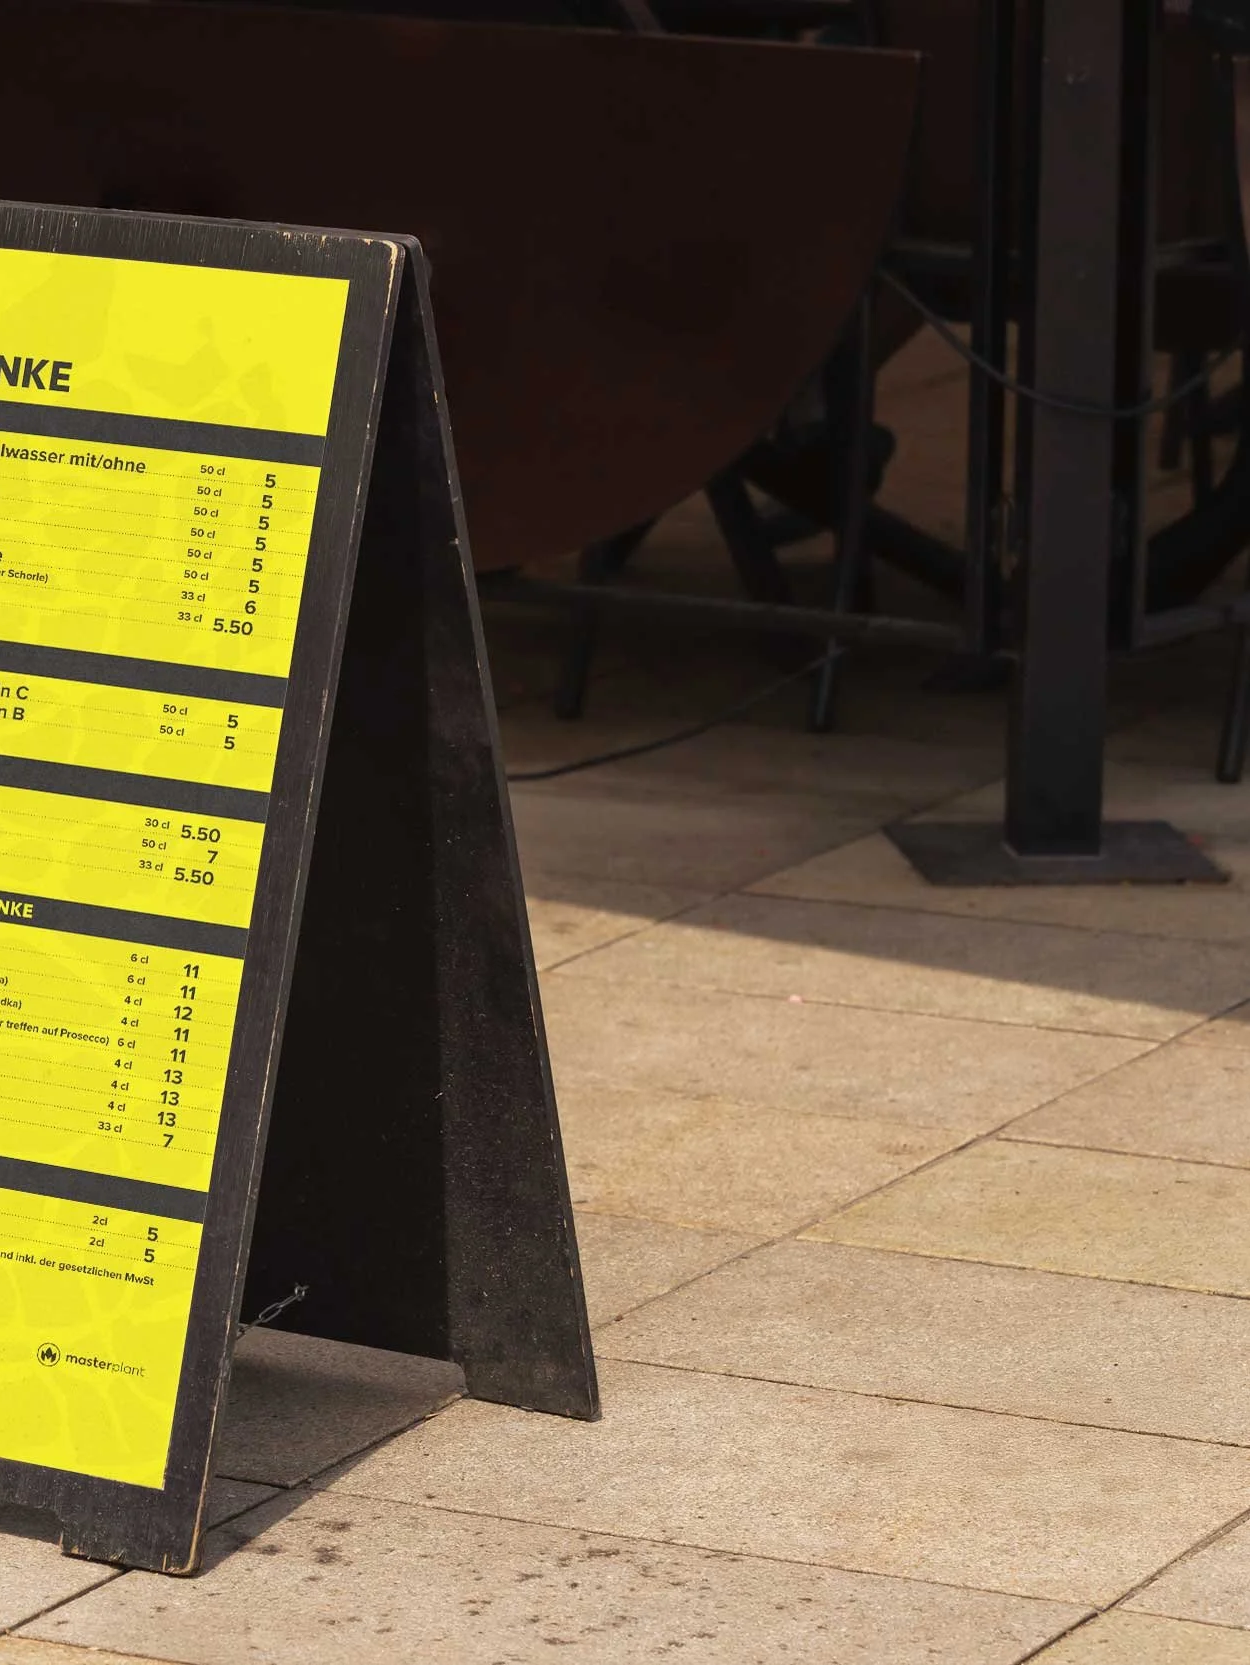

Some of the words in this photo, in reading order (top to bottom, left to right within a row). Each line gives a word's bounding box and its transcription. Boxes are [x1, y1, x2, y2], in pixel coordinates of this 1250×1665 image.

[69, 452, 146, 474] mit/ohne
[200, 464, 215, 475] 50
[216, 467, 226, 476] cl
[265, 473, 277, 489] 5
[197, 485, 211, 496] 50
[261, 494, 273, 510] 5
[193, 506, 208, 516] 50
[258, 515, 270, 531] 5
[190, 527, 205, 538] 50
[255, 536, 267, 552] 5
[187, 548, 202, 559] 50
[203, 551, 213, 560] cl
[251, 557, 263, 573] 5
[7, 568, 49, 584] Schorle)
[181, 590, 195, 601] 33
[244, 600, 257, 615] 6
[183, 569, 198, 579] 50
[248, 579, 260, 594] 5
[177, 611, 191, 622] 33
[212, 618, 254, 636] 5.50
[15, 685, 30, 701] C
[162, 704, 177, 714] 50
[179, 707, 188, 716] cl
[227, 714, 239, 729] 5
[12, 706, 25, 721] B
[159, 724, 174, 735] 50
[223, 735, 235, 750] 5
[144, 817, 159, 828] 30
[180, 824, 221, 843] 5.50
[141, 838, 156, 849] 50
[158, 841, 167, 851] cl
[207, 849, 219, 864] 7
[139, 859, 153, 870] 33
[173, 866, 214, 886] 5.50
[130, 953, 138, 963] 6
[140, 955, 149, 964] cl
[183, 963, 200, 979] 11
[127, 974, 135, 984] 6
[180, 985, 196, 1001] 11
[124, 995, 131, 1005] 4
[173, 1005, 193, 1021] 12
[6, 1020, 39, 1033] treffen
[41, 1027, 59, 1037] auf
[59, 1028, 110, 1047] Prosecco)
[117, 1037, 125, 1047] 6
[170, 1048, 186, 1064] 11
[120, 1016, 128, 1026] 4
[173, 1027, 190, 1043] 11
[114, 1058, 121, 1068] 4
[123, 1061, 133, 1070] cl
[164, 1069, 183, 1085] 13
[110, 1080, 118, 1089] 4
[160, 1090, 180, 1106] 13
[107, 1101, 115, 1111] 4
[157, 1111, 176, 1128] 13
[97, 1121, 111, 1132] 33
[163, 1133, 174, 1148] 7
[92, 1215, 108, 1226] 2cl
[147, 1226, 159, 1242] 5
[89, 1236, 105, 1248] 2cl
[143, 1247, 155, 1263] 5
[15, 1252, 37, 1265] inkl.
[39, 1257, 56, 1268] der
[58, 1262, 122, 1280] gesetzlichen
[124, 1272, 155, 1286] MwSt
[65, 1354, 145, 1378] masterplant
